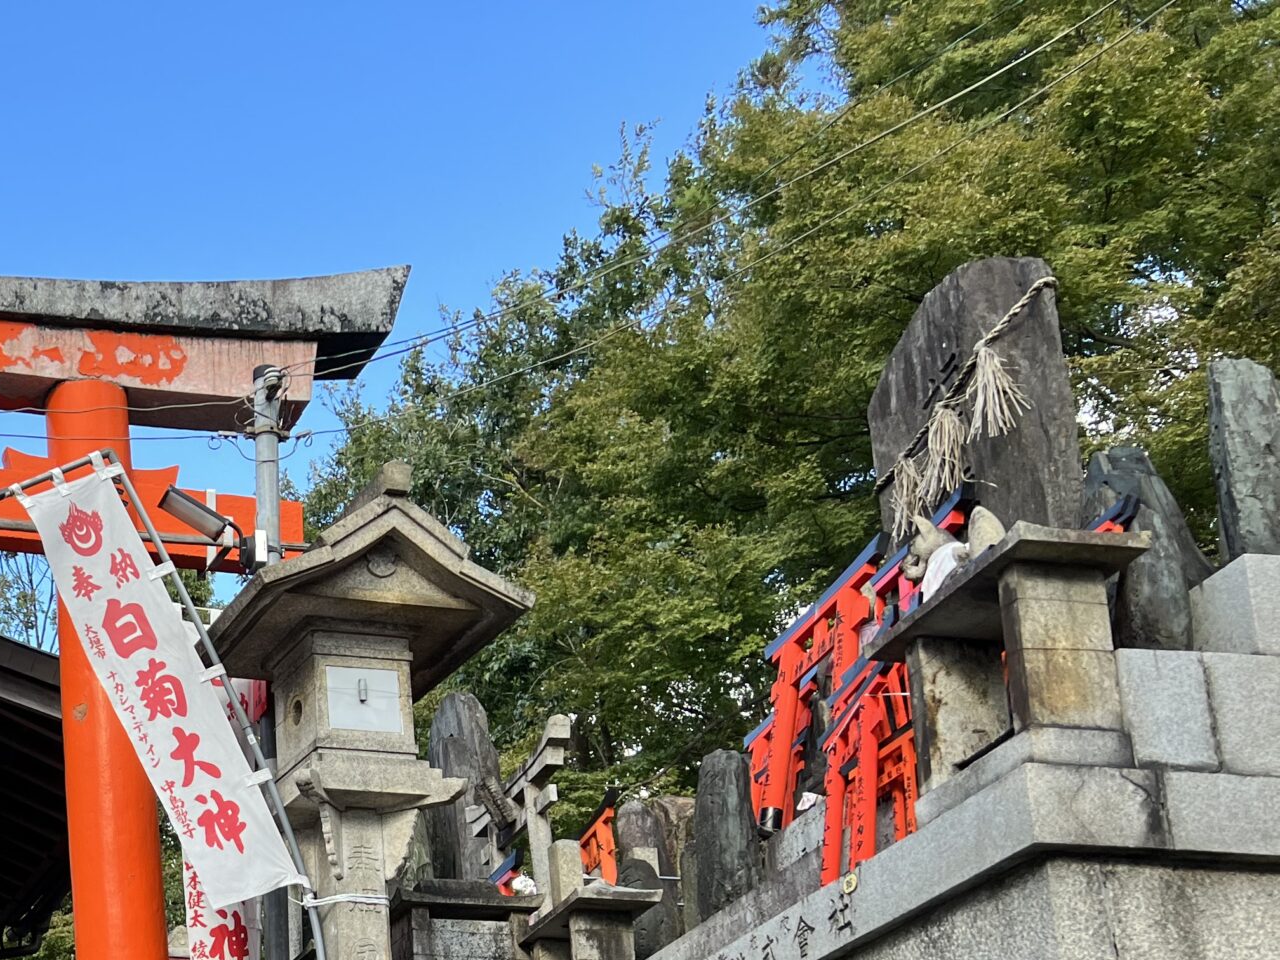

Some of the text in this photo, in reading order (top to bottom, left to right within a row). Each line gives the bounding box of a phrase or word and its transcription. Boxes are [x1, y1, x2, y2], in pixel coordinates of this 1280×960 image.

[72, 547, 140, 602] 奉納
[84, 623, 107, 660] 大垣市
[101, 598, 247, 855] 白菊大神
